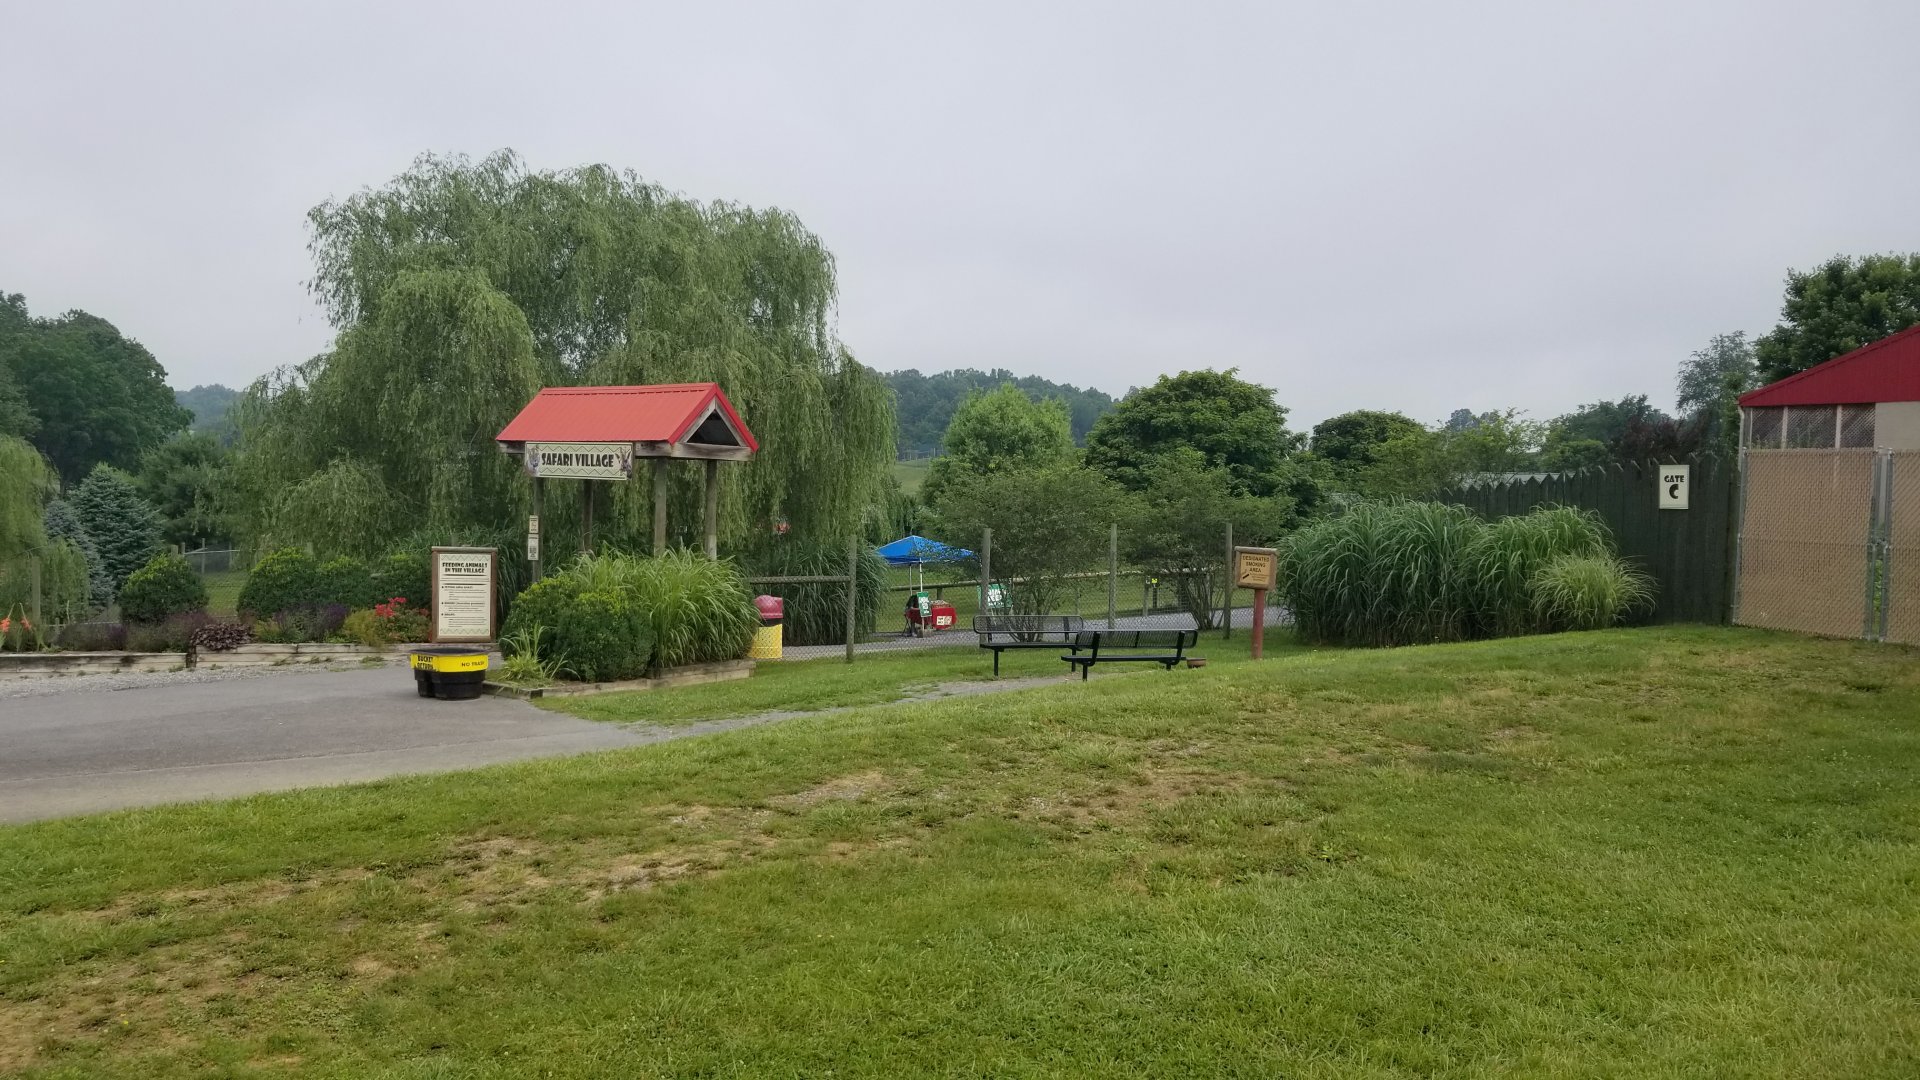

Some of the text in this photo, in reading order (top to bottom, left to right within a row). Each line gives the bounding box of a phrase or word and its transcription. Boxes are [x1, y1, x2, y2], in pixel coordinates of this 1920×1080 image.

[541, 453, 614, 467] SAFARI VILLAGE
[1664, 475, 1685, 483] GATE
[1669, 484, 1679, 499] C
